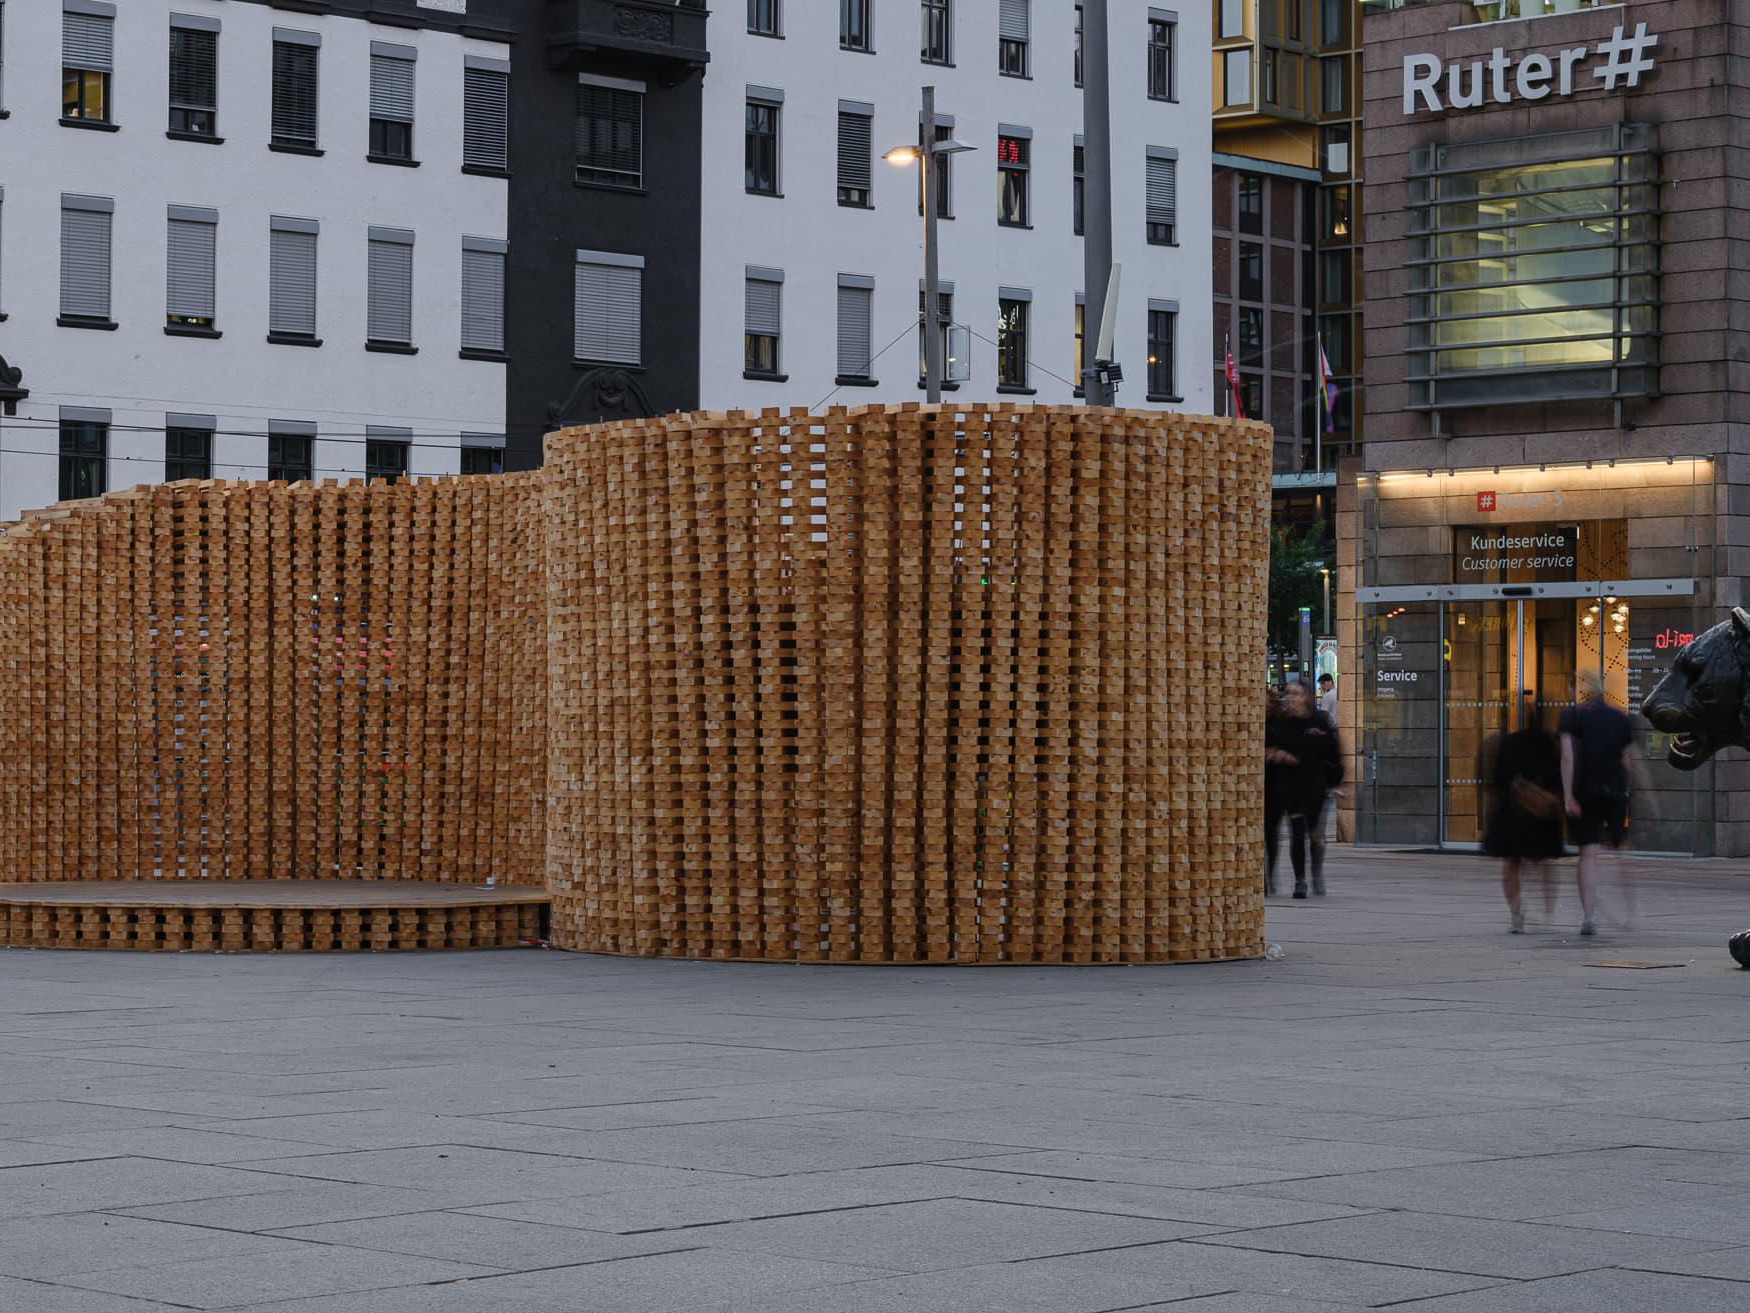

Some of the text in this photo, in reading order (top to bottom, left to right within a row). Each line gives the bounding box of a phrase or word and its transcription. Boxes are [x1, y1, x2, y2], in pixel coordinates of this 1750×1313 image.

[1471, 533, 1565, 550] Kundeservice
[1462, 554, 1574, 571] Customer service
[1377, 669, 1418, 682] Service
